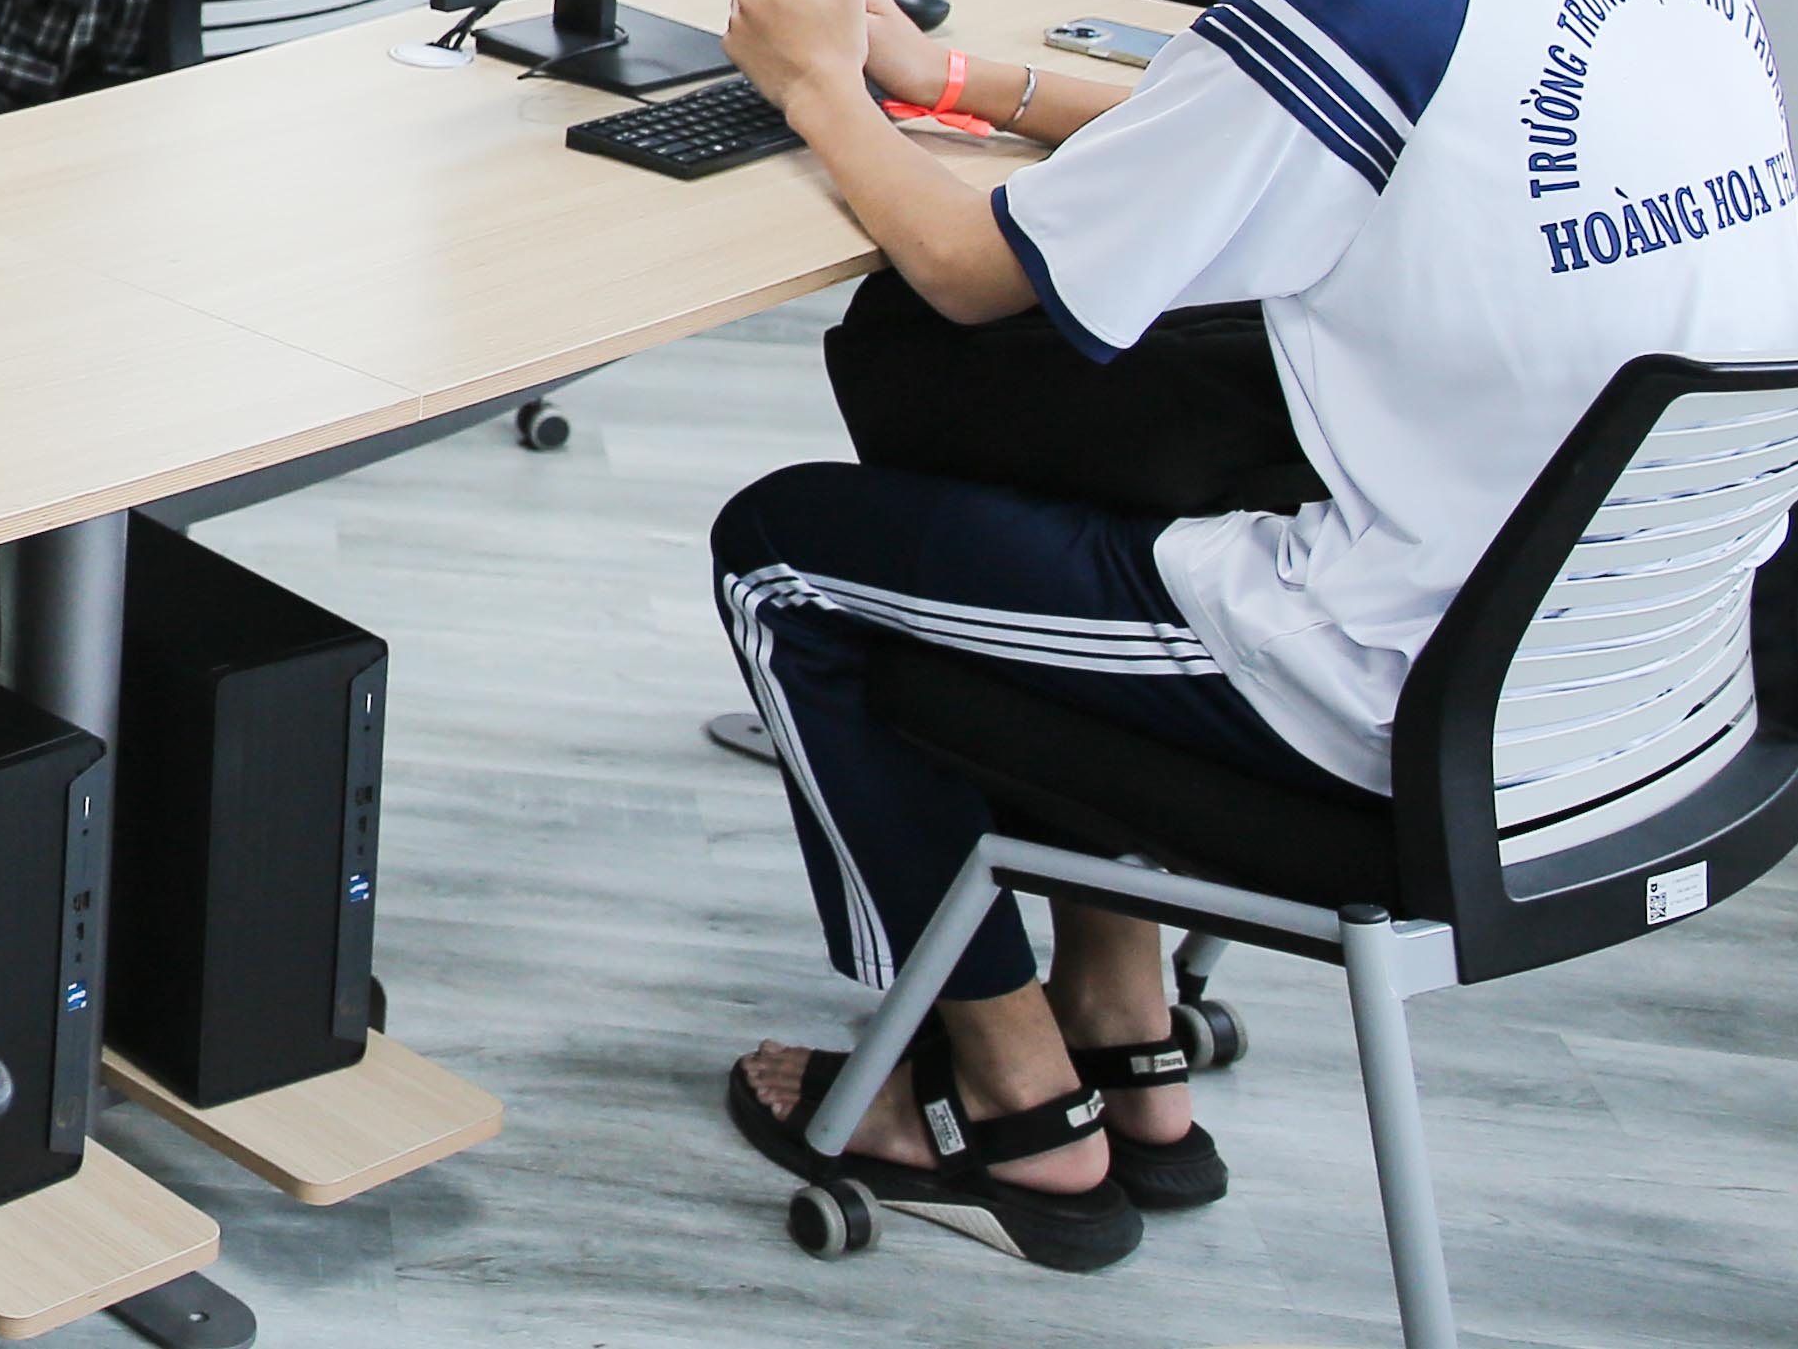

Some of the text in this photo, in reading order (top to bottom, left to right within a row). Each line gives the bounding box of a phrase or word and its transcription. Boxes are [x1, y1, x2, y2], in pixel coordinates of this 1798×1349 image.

[1520, 45, 1588, 198] TRƯỜNG
[1540, 187, 1710, 274] HOÀNG
[1704, 164, 1772, 230] HOA
